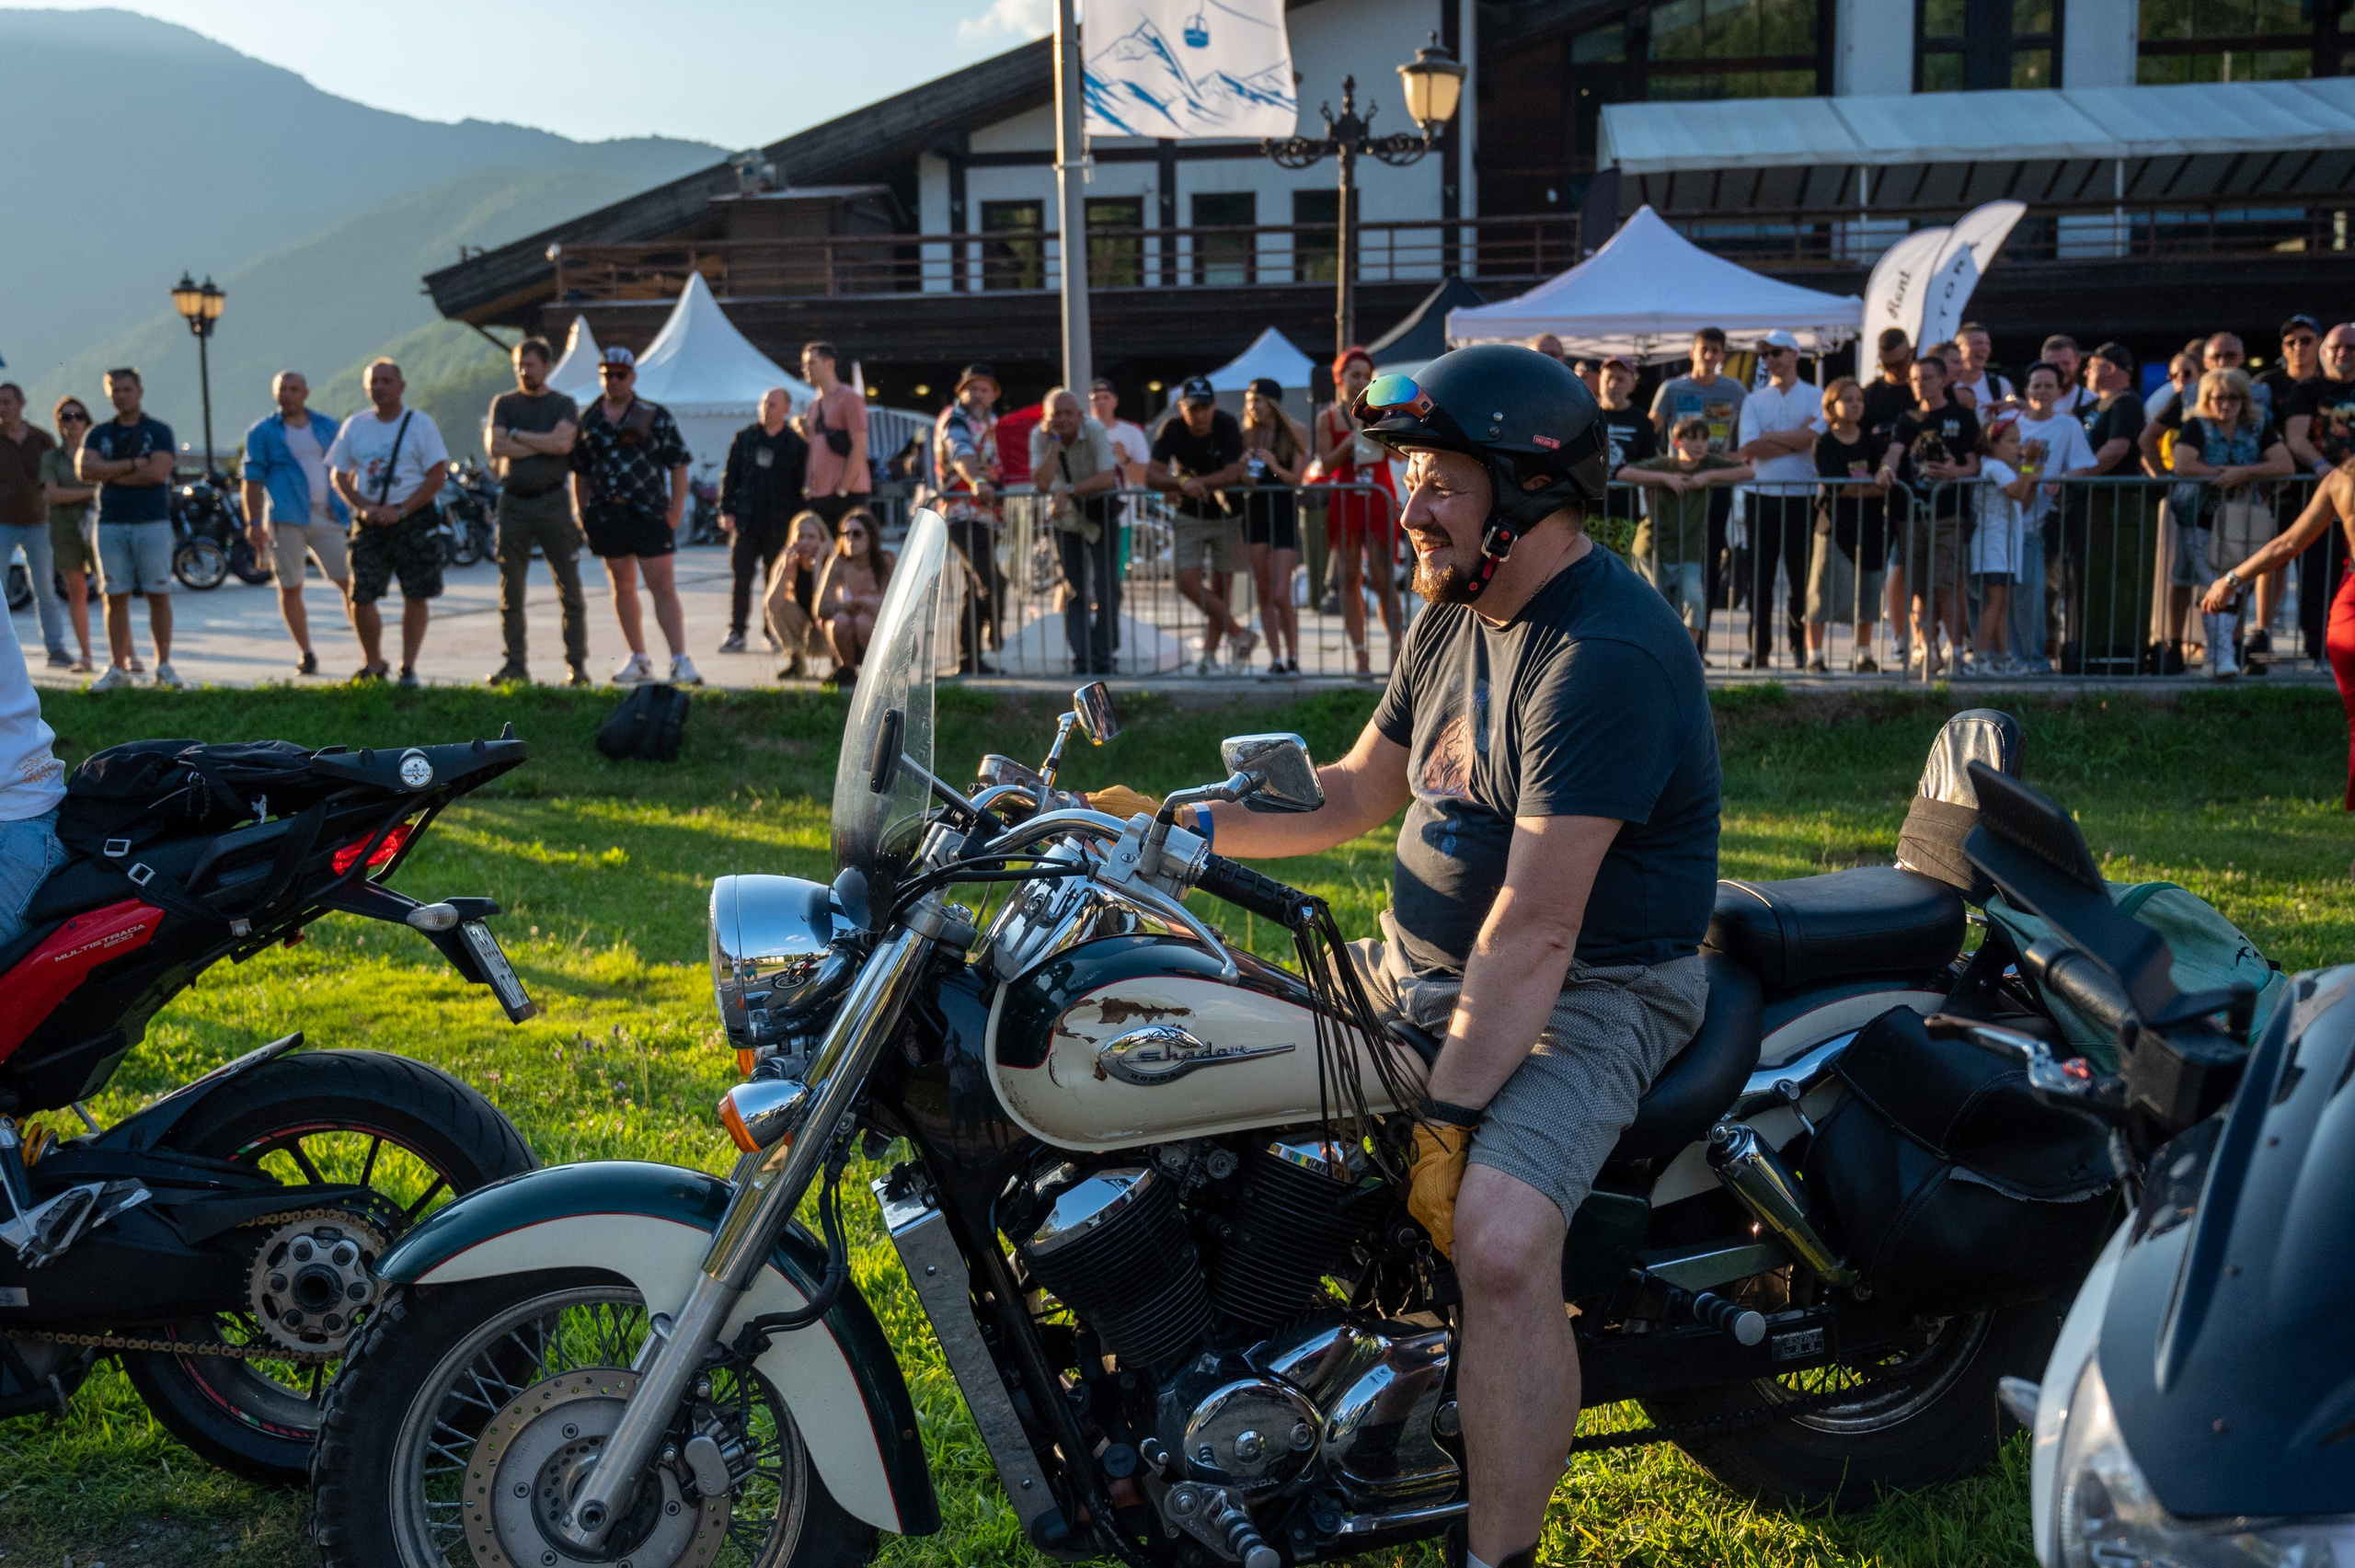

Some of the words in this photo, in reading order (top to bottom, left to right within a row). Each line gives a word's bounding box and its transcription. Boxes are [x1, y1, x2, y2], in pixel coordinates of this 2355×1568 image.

[54, 923, 146, 962] MULTISTRADA
[104, 933, 134, 948] 1200
[1125, 1041, 1248, 1061] Shadow
[1130, 1071, 1177, 1082] HONDA
